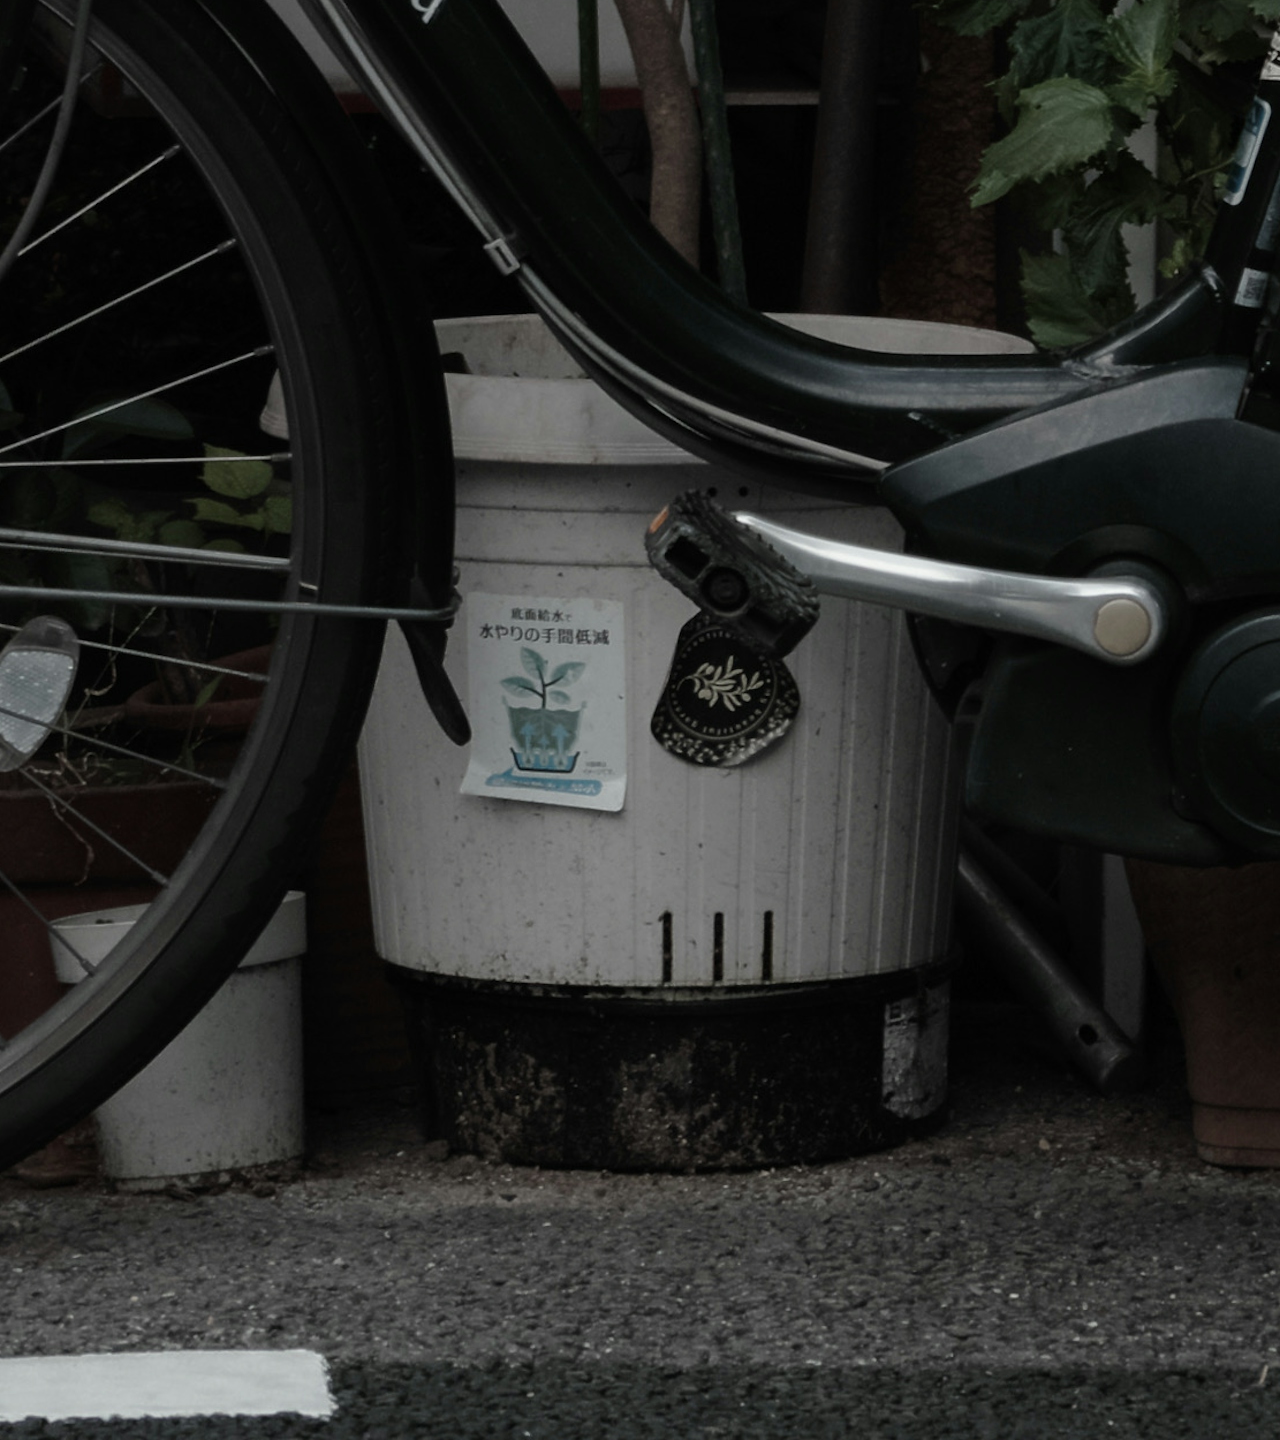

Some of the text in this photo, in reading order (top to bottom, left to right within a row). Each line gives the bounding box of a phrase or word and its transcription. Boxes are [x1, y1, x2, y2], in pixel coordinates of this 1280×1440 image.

[479, 623, 611, 646] 水やりの手間低減
